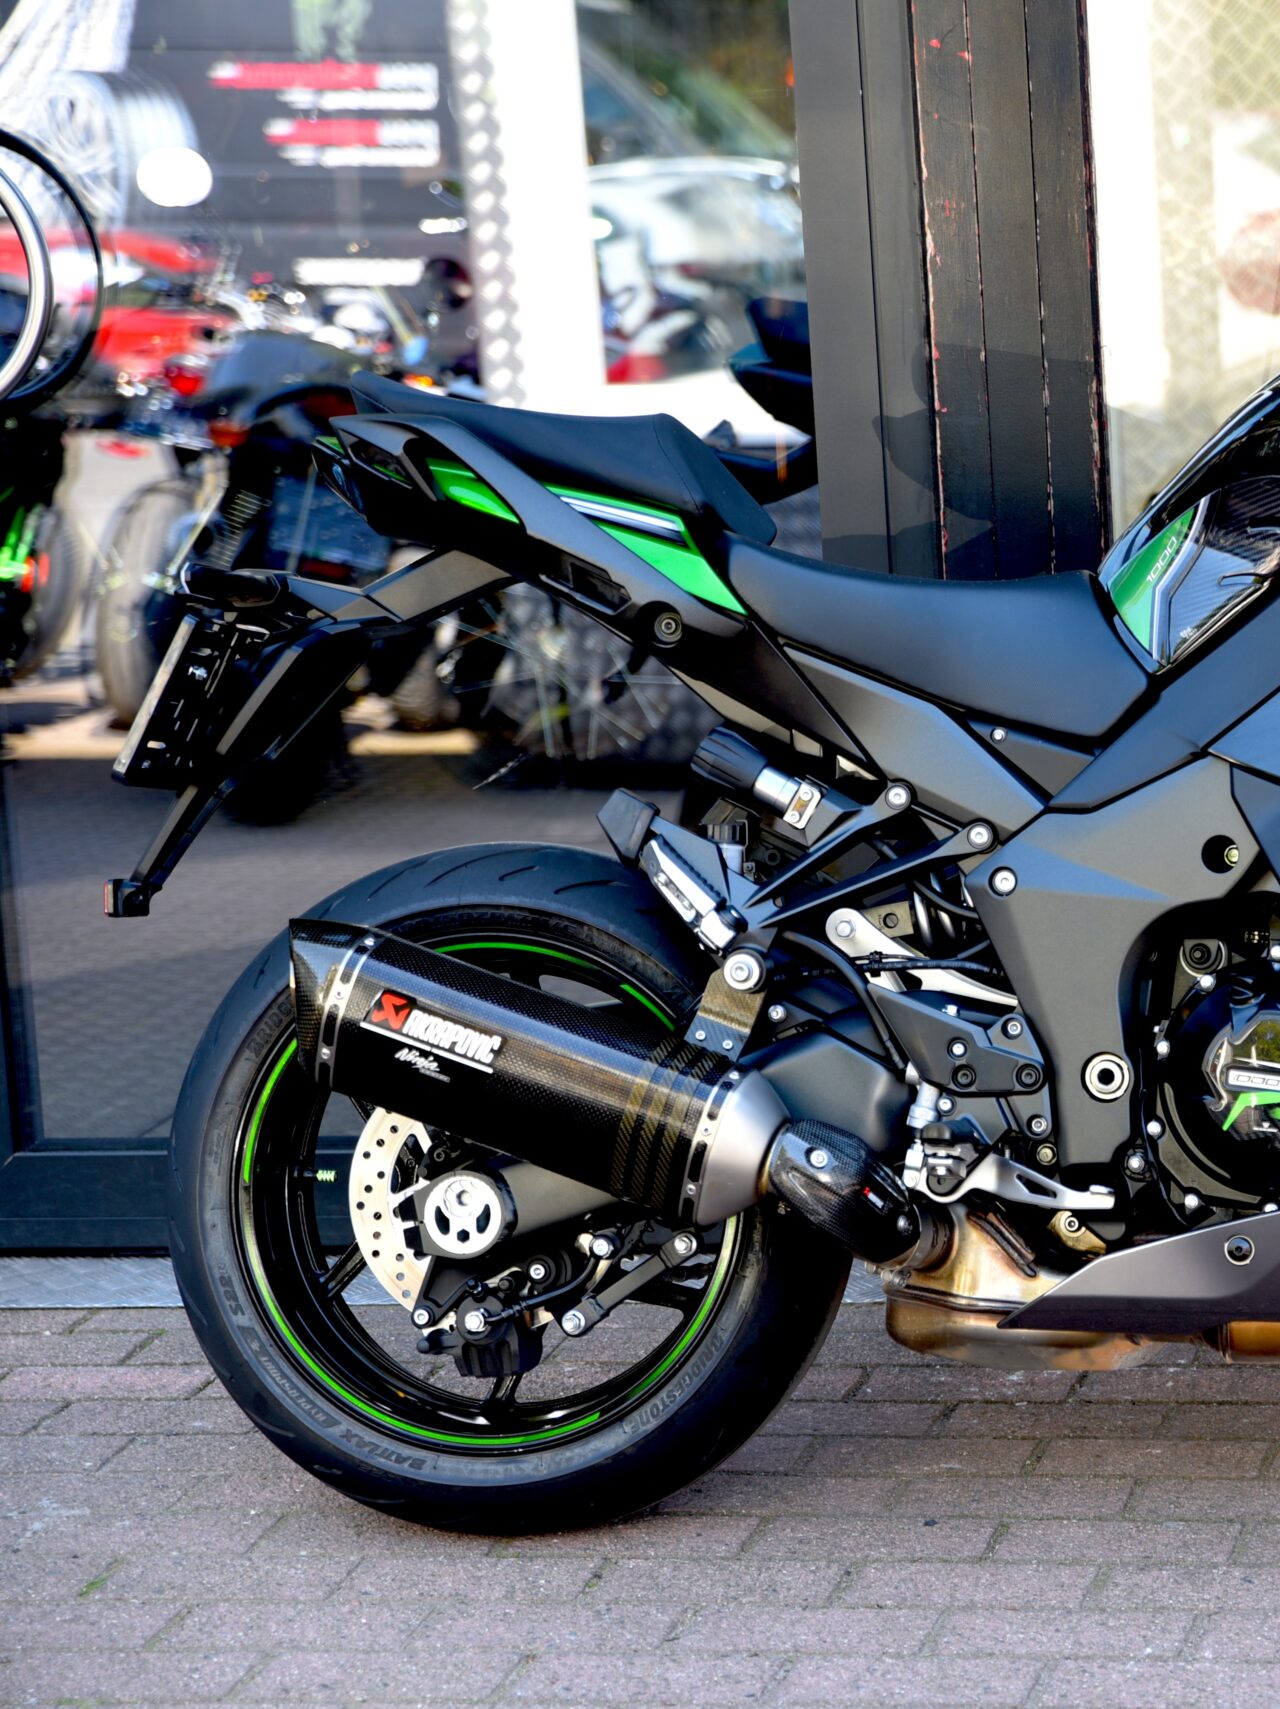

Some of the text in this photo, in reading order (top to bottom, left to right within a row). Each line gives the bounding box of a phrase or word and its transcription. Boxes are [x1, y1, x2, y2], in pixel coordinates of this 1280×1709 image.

[1146, 535, 1177, 582] 1000
[249, 997, 294, 1059] BRIDG
[394, 1047, 440, 1073] Ninja
[261, 1356, 329, 1423] HYPERSPORT
[629, 1329, 727, 1436] BRIDGESTONE
[339, 1428, 429, 1472] BATTLAX
